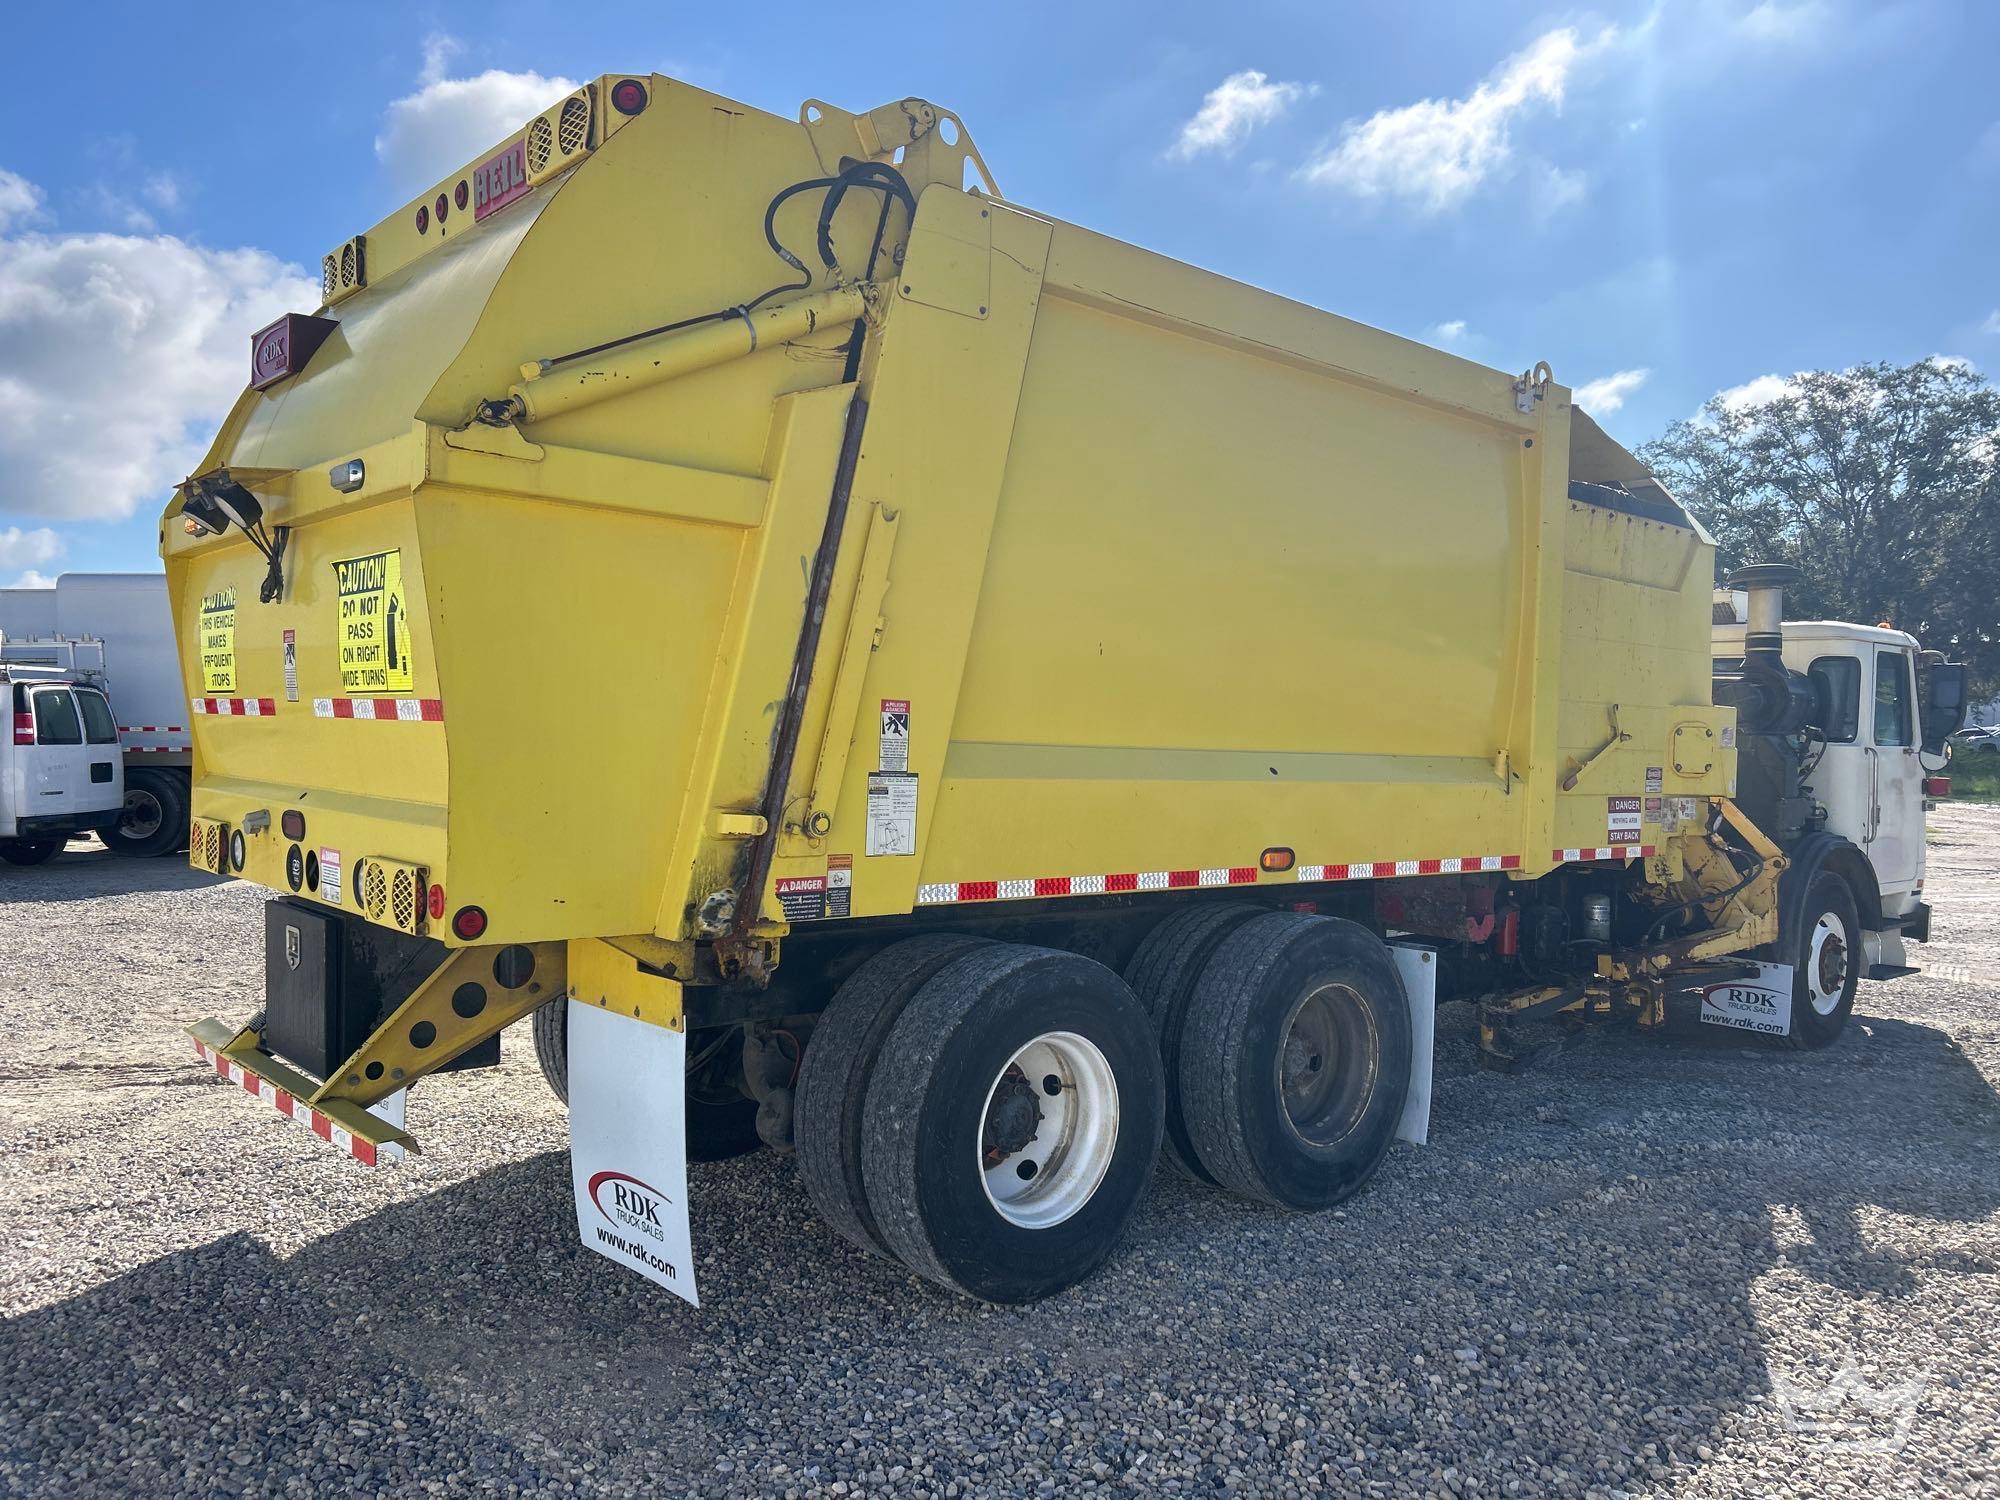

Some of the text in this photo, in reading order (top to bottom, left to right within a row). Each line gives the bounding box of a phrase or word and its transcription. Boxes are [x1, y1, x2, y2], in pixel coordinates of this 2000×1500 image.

[475, 150, 523, 208] HEIL
[263, 337, 285, 364] RDK
[339, 556, 385, 594] CAUTION!
[360, 596, 379, 616] NOT
[213, 614, 234, 629] VEHICLE
[347, 622, 373, 640] PASS
[207, 634, 226, 649] MAKES
[342, 645, 380, 664] ON RIGHT
[341, 668, 386, 687] WIDE TURNS
[1615, 800, 1640, 810] DANGER
[1610, 831, 1639, 841] STAY BACK
[789, 879, 823, 891] DANGER
[1728, 988, 1777, 1008] RDK
[1727, 1001, 1777, 1016] TRUCK SALES
[1702, 1012, 1784, 1034] www.rdk.com
[613, 1181, 662, 1228] RDK
[616, 1207, 664, 1242] TRUCK SALES
[596, 1226, 677, 1280] www.rdk.com
